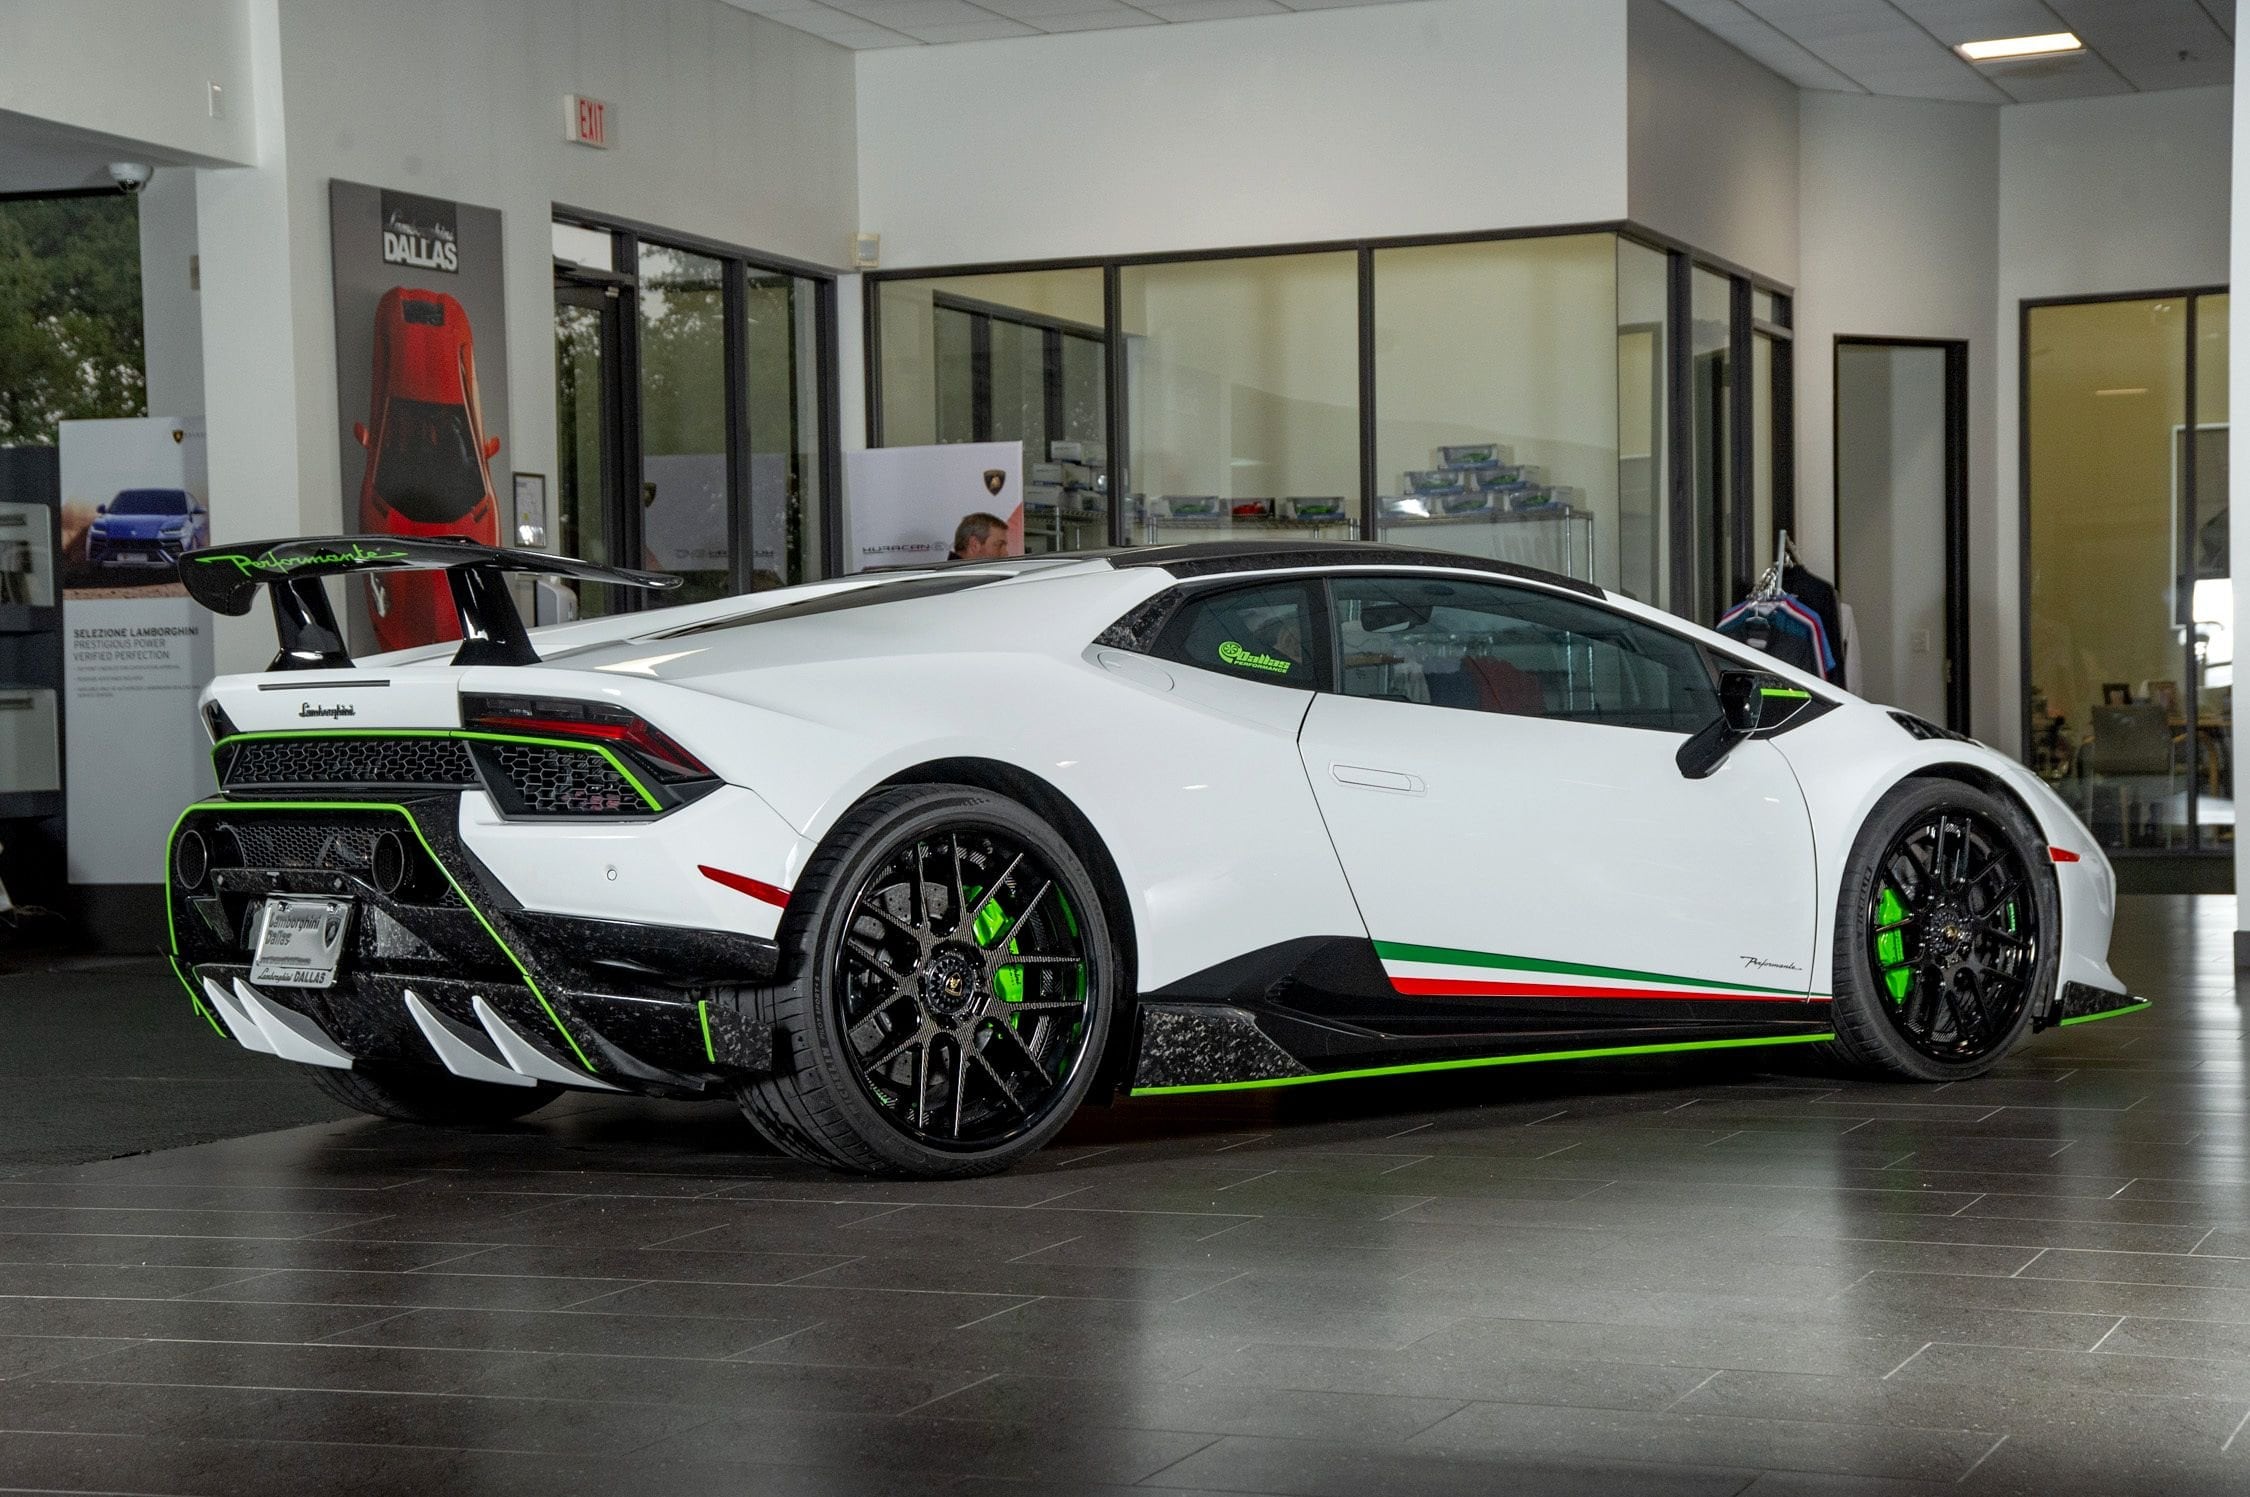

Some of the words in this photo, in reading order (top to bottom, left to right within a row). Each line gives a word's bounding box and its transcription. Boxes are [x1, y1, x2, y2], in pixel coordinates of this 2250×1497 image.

[580, 99, 604, 143] EXIT
[383, 231, 458, 271] DALLAS
[194, 543, 408, 577] Performante
[73, 628, 128, 638] SELEZIONE
[130, 626, 199, 637] LAMBORGHINI
[73, 639, 132, 649] PRESTIGIOUS
[134, 639, 166, 648] POWER
[73, 651, 113, 661] VERIFIED
[115, 650, 170, 660] PERFECTION
[1234, 660, 1287, 674] PERFORMANCE
[299, 702, 356, 720] Lamborghini
[268, 912, 322, 932] Lamborghini
[265, 930, 292, 946] Dallas
[1740, 956, 1802, 970] Performante
[293, 971, 326, 984] DALLAS
